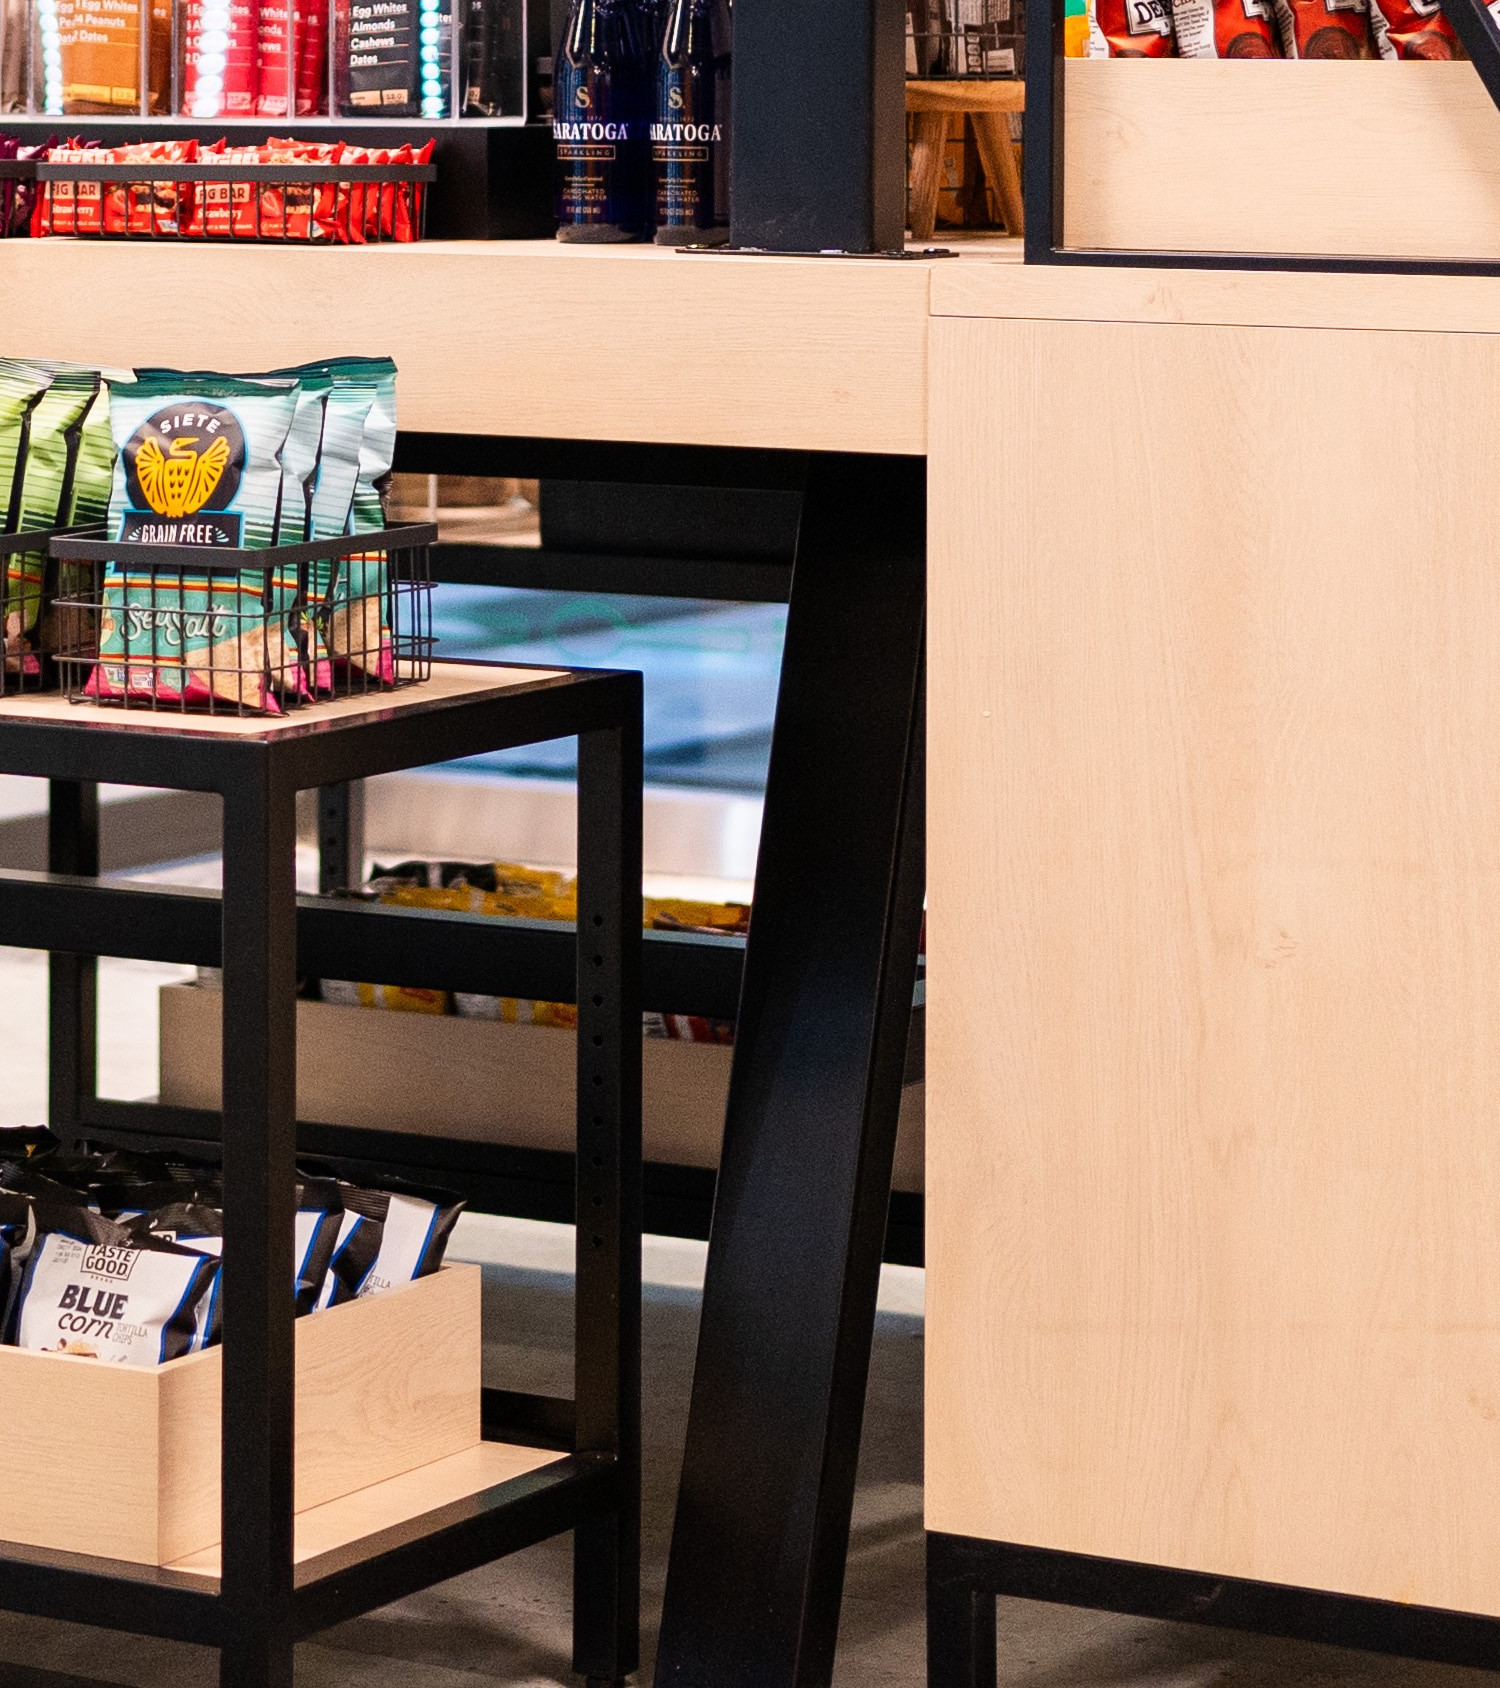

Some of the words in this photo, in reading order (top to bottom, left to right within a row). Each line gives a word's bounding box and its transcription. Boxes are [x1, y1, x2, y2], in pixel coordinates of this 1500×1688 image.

[352, 4, 371, 19] Egg
[373, 2, 407, 15] Whites
[85, 13, 125, 27] Peanuts
[352, 19, 395, 33] Almonds
[80, 29, 109, 42] Dates
[351, 36, 394, 48] Cashews
[350, 52, 378, 66] Dates
[650, 123, 722, 141] ARATOGA
[160, 412, 221, 434] SIETE
[142, 523, 177, 544] GRAIN
[178, 524, 214, 544] FREE
[87, 1244, 135, 1262] TASTE
[56, 1283, 130, 1320] BLUE
[57, 1312, 115, 1339] corn
[114, 1322, 148, 1339] TORTILLA
[111, 1332, 133, 1346] CHIPS
